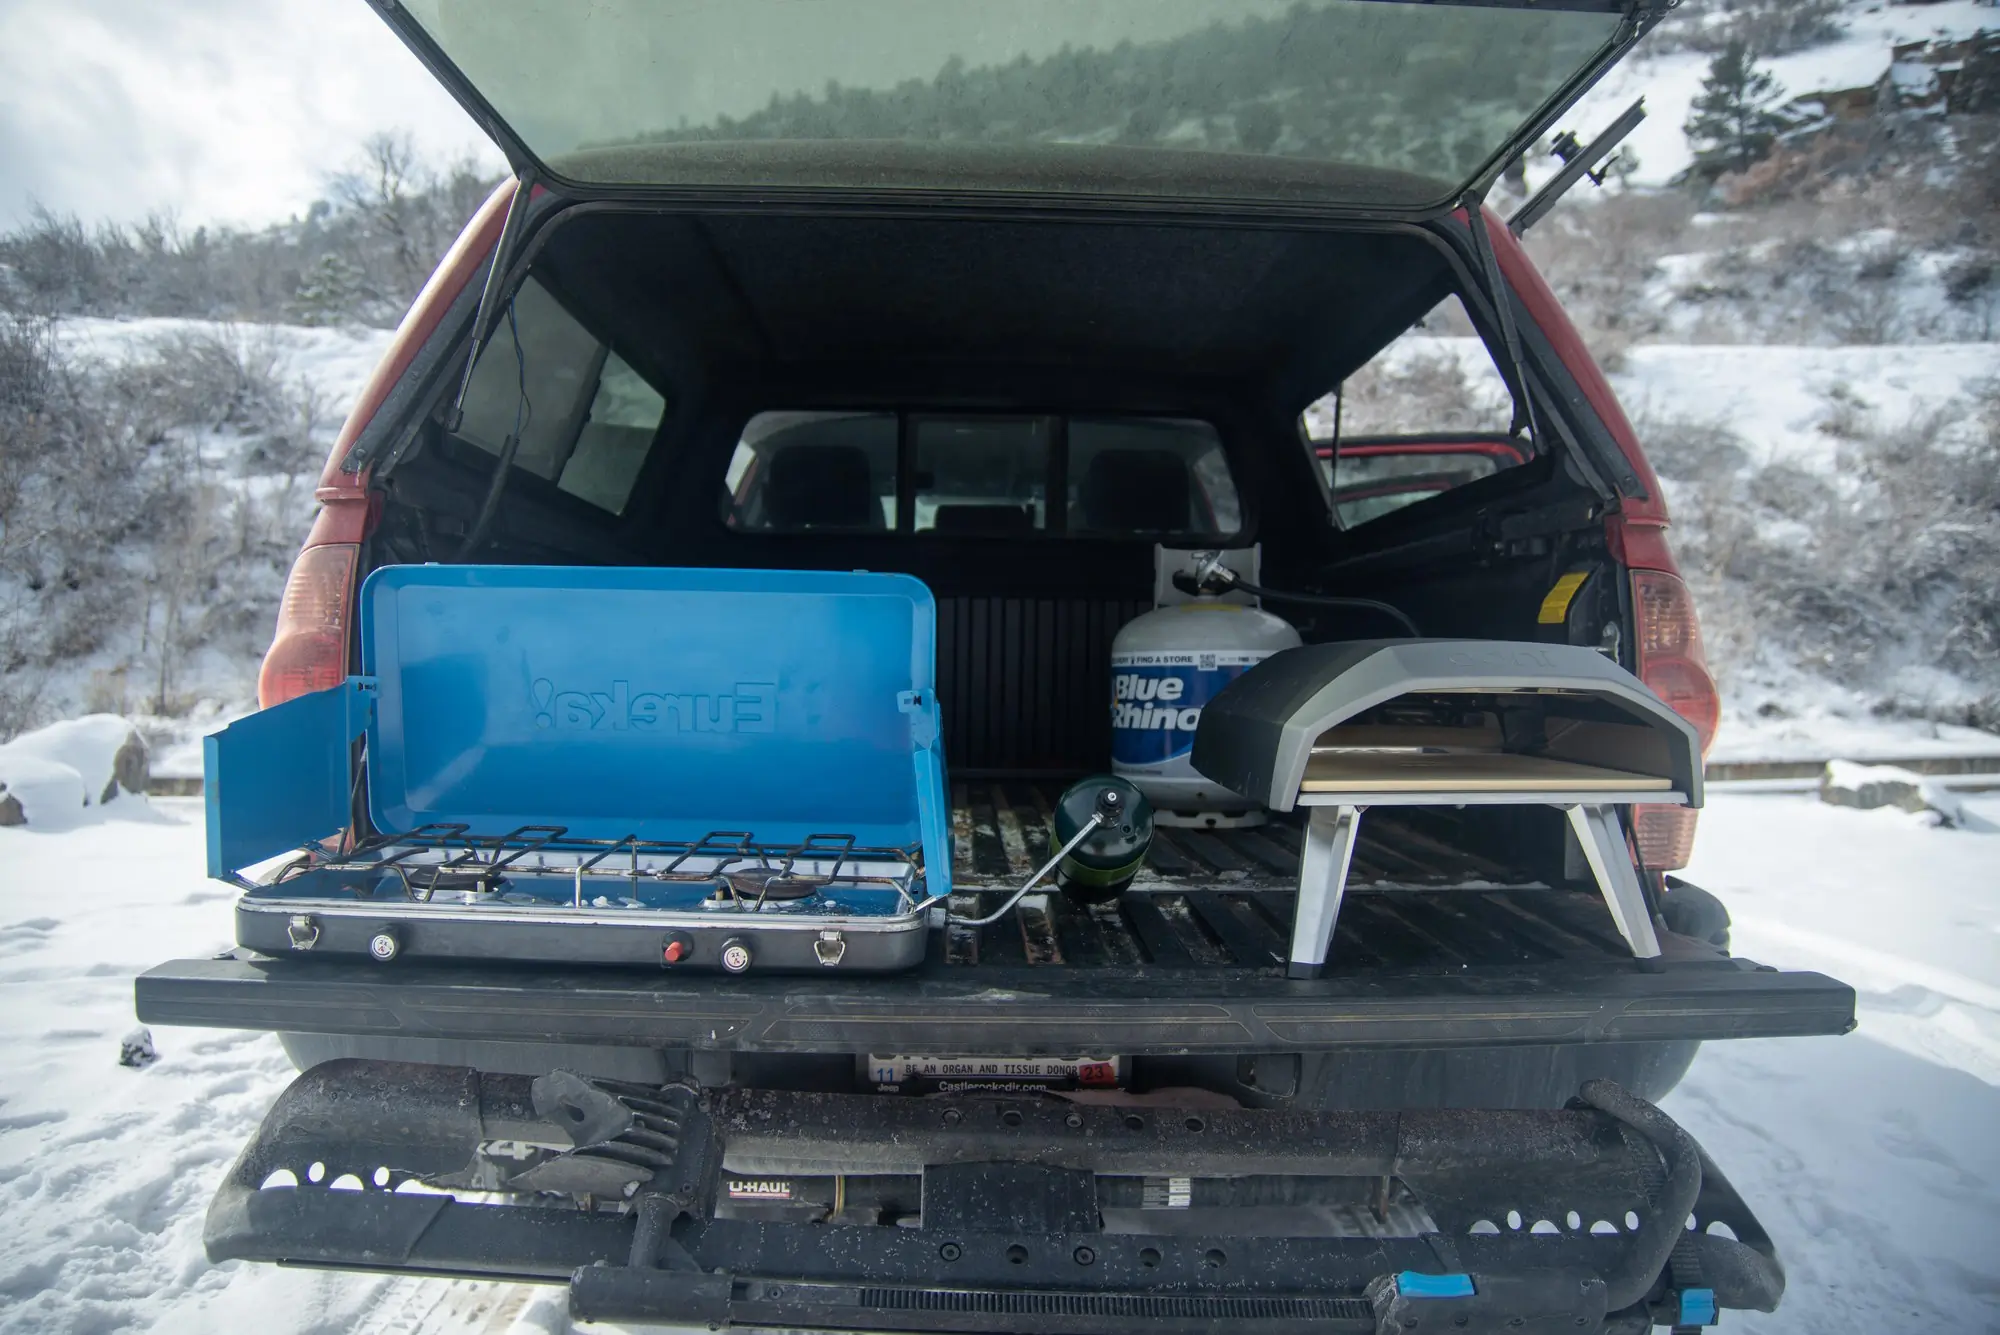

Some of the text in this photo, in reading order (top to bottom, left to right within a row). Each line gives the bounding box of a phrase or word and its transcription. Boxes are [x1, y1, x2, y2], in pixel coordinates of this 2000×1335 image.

[1163, 655, 1194, 663] STORE
[1116, 674, 1184, 700] Blue
[877, 1068, 893, 1081] 11
[905, 1064, 1078, 1076] BE AN ORGAN AND TISSUE DONOR
[1084, 1066, 1104, 1079] 23
[729, 1180, 790, 1193] U-HAUL
